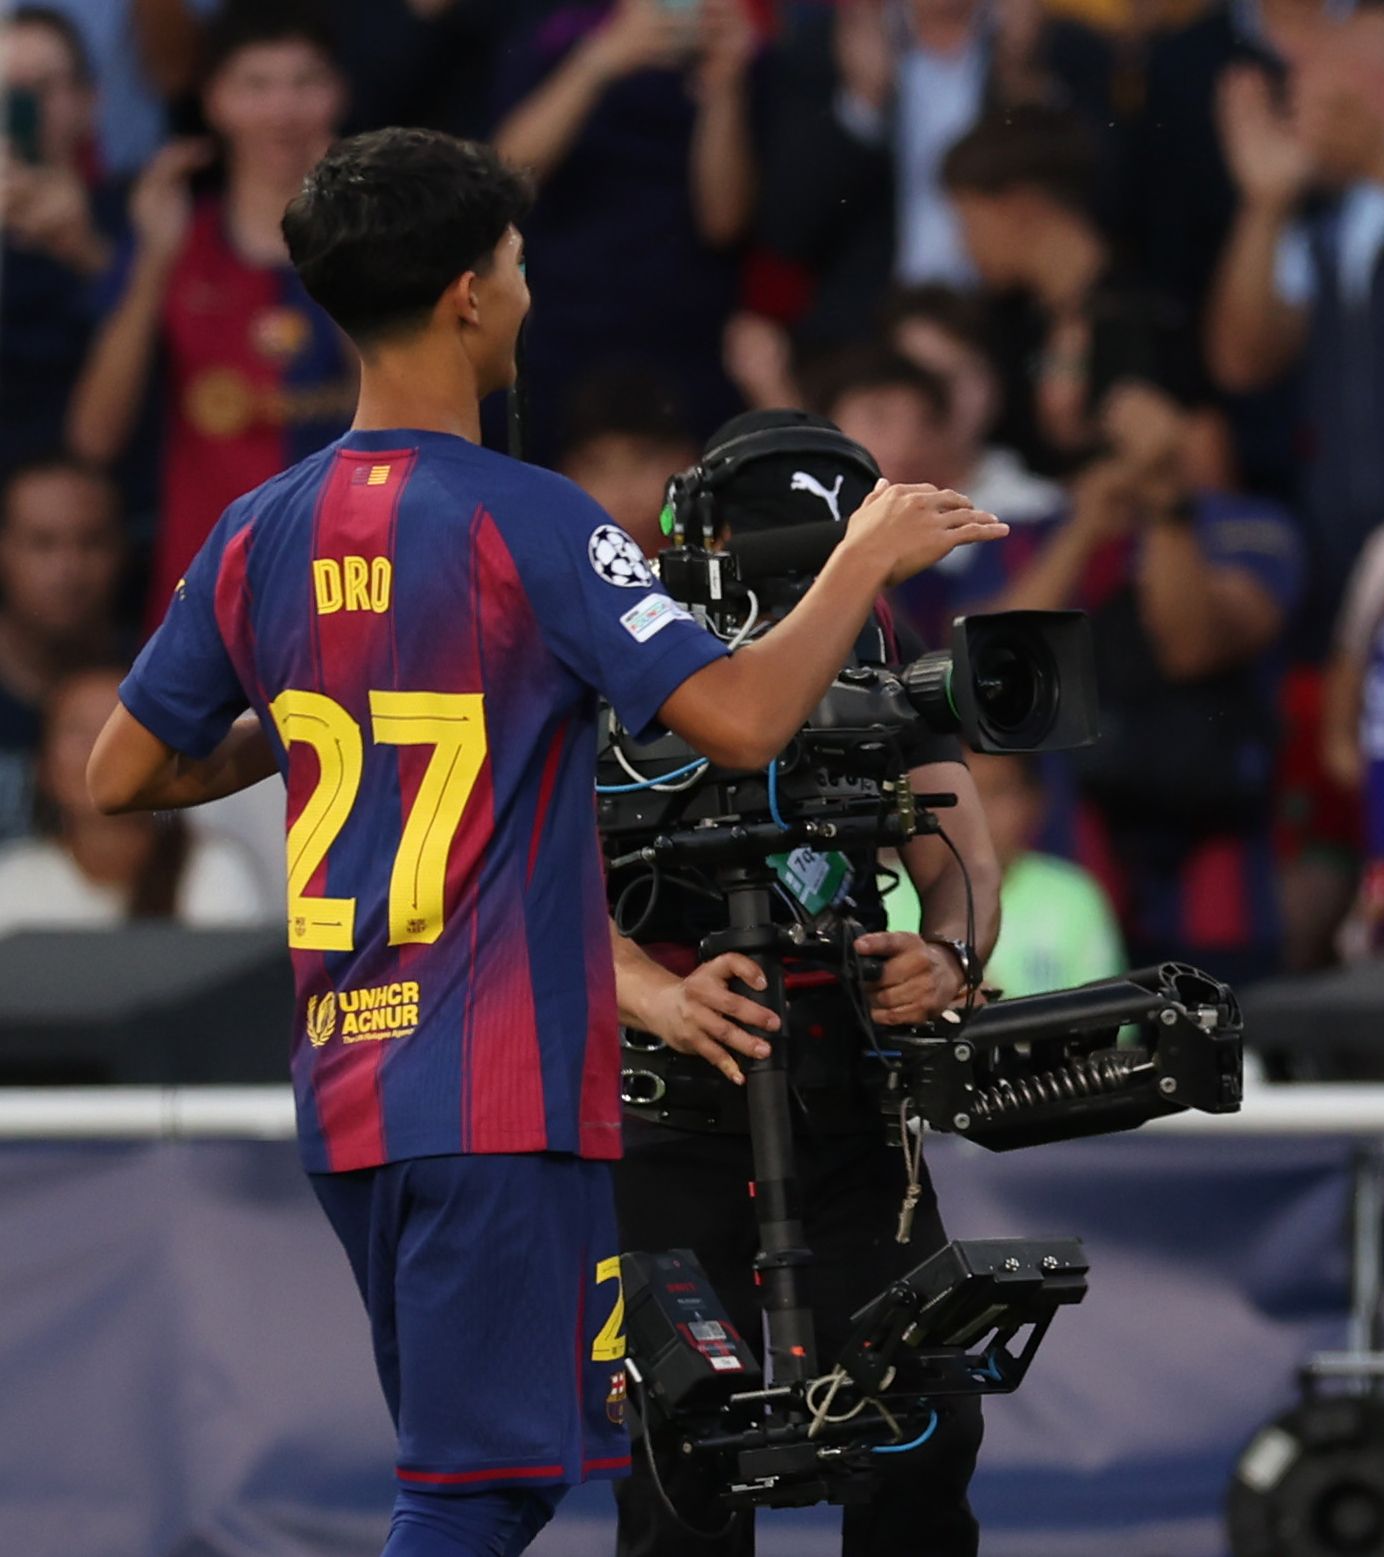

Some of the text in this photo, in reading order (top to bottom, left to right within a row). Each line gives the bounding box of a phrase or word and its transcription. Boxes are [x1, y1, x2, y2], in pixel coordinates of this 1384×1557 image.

[313, 555, 392, 615] DRO
[269, 690, 487, 950] 27
[339, 982, 418, 1011] UNHCR
[342, 1005, 418, 1034] ACNUR
